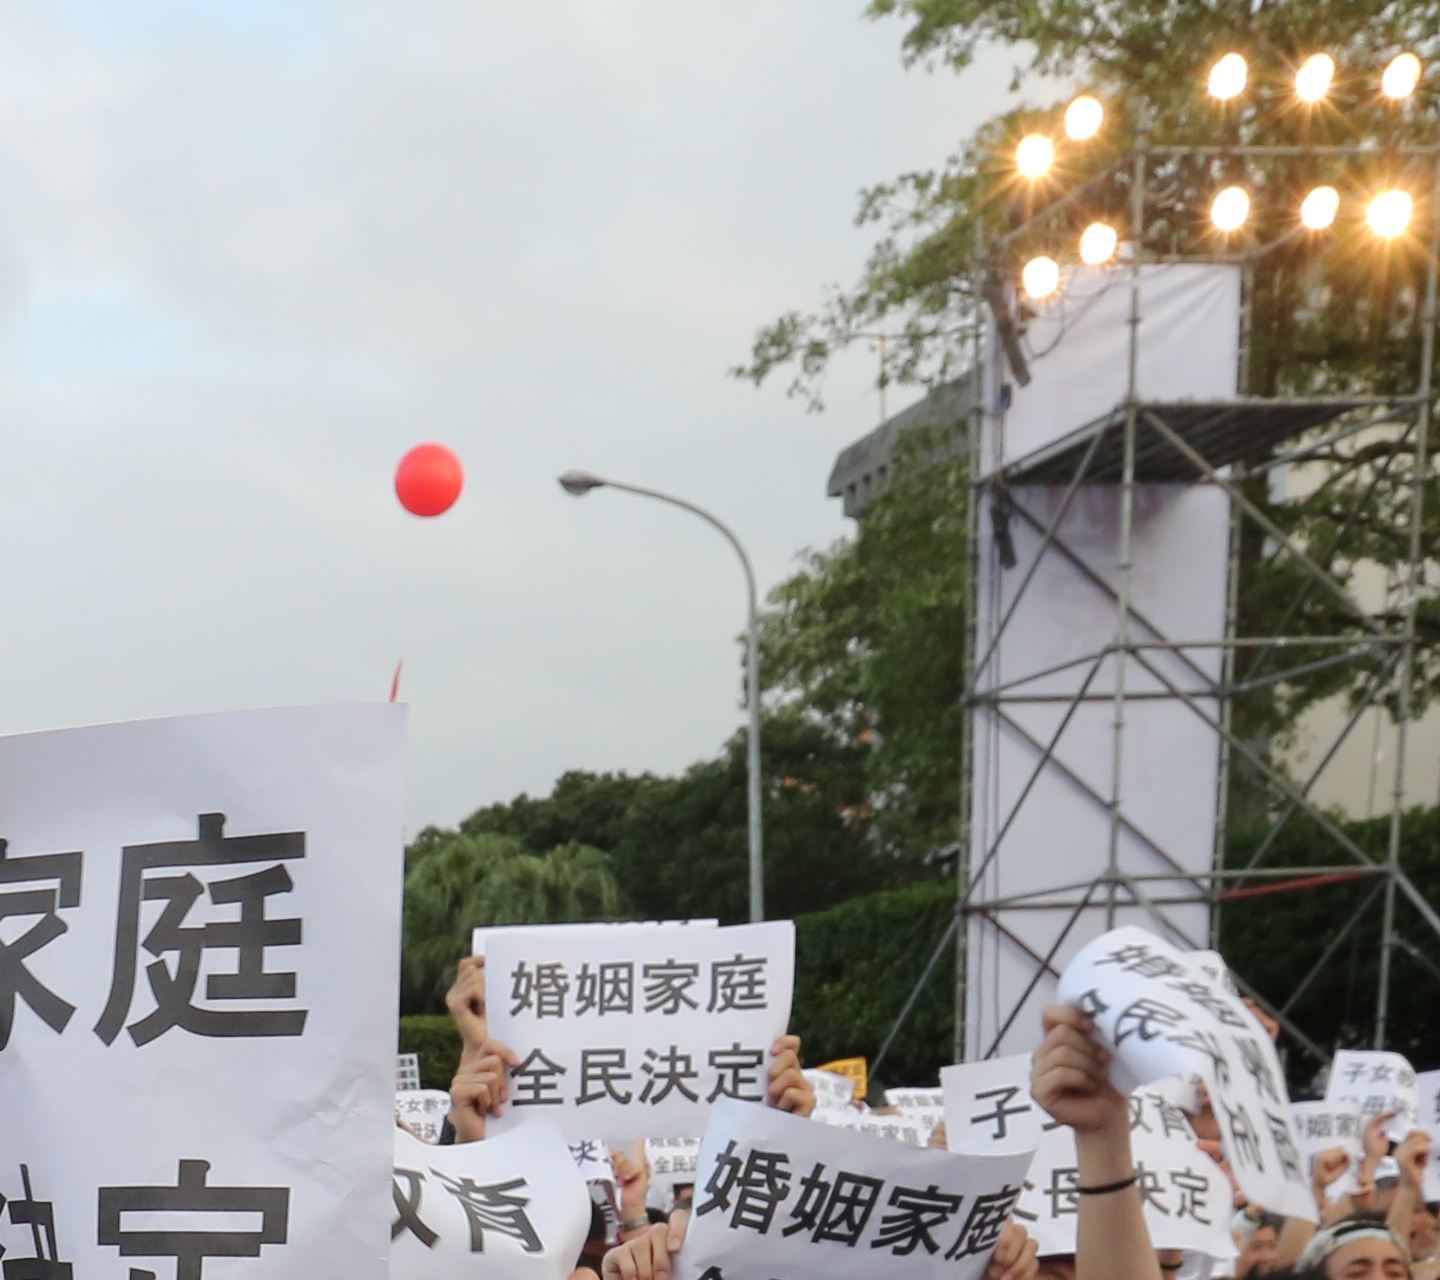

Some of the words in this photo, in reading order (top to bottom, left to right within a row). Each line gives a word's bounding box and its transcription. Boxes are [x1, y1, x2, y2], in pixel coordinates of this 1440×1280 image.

[511, 954, 770, 1020] 婚姻家庭
[509, 1043, 766, 1107] 全民決定
[696, 1140, 1023, 1263] 婚姻家庭
